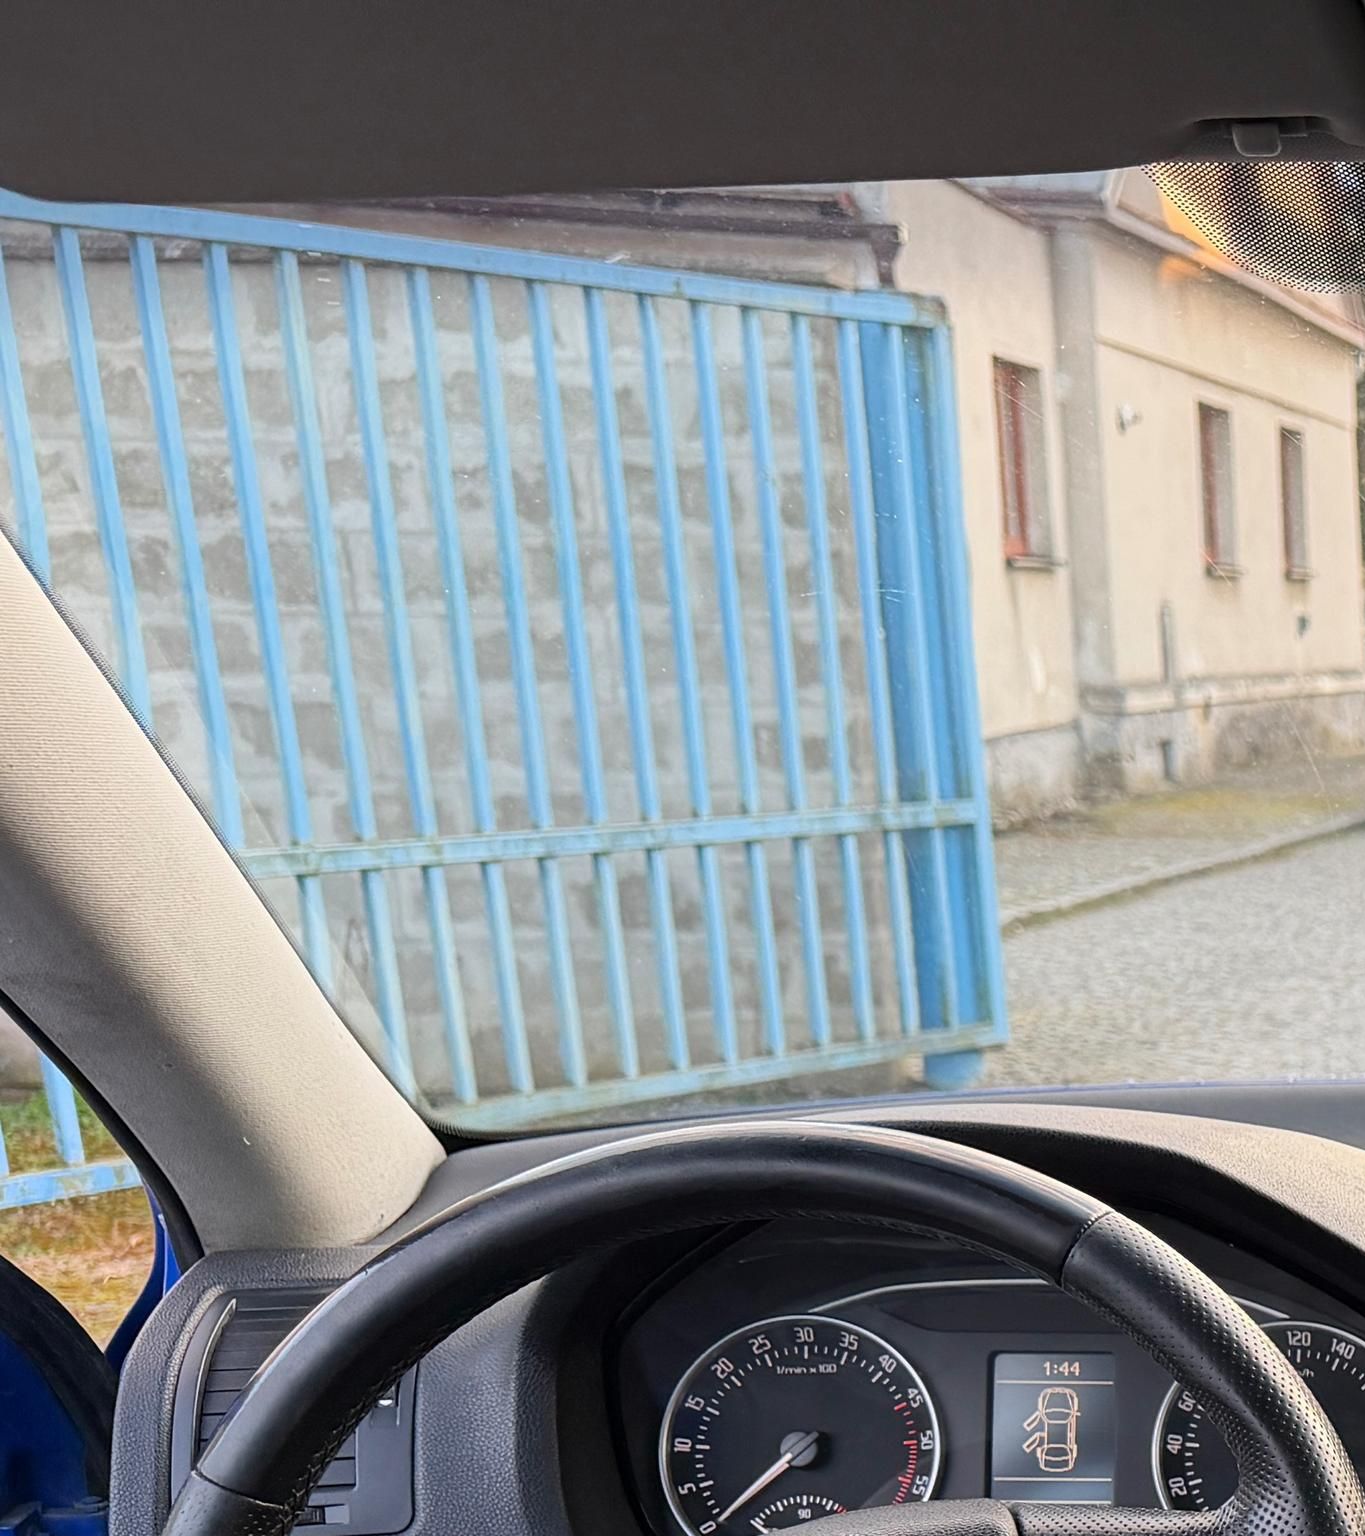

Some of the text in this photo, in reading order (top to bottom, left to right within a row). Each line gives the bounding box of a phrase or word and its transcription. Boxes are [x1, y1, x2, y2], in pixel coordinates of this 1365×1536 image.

[749, 1335, 771, 1355] 25
[794, 1327, 814, 1344] 30
[839, 1331, 859, 1351] 35
[1286, 1330, 1311, 1347] 120
[1330, 1338, 1356, 1361] 140
[711, 1357, 734, 1379] 20
[878, 1354, 897, 1373] 40
[1043, 1361, 1081, 1377] 1:44
[684, 1394, 706, 1412] 15
[906, 1387, 925, 1409] 45
[673, 1437, 693, 1453] 10
[920, 1430, 934, 1451] 50
[1166, 1434, 1184, 1455] 40
[678, 1482, 697, 1496] 5
[912, 1475, 930, 1497] 55
[1168, 1476, 1188, 1498] 20
[798, 1508, 812, 1520] 90
